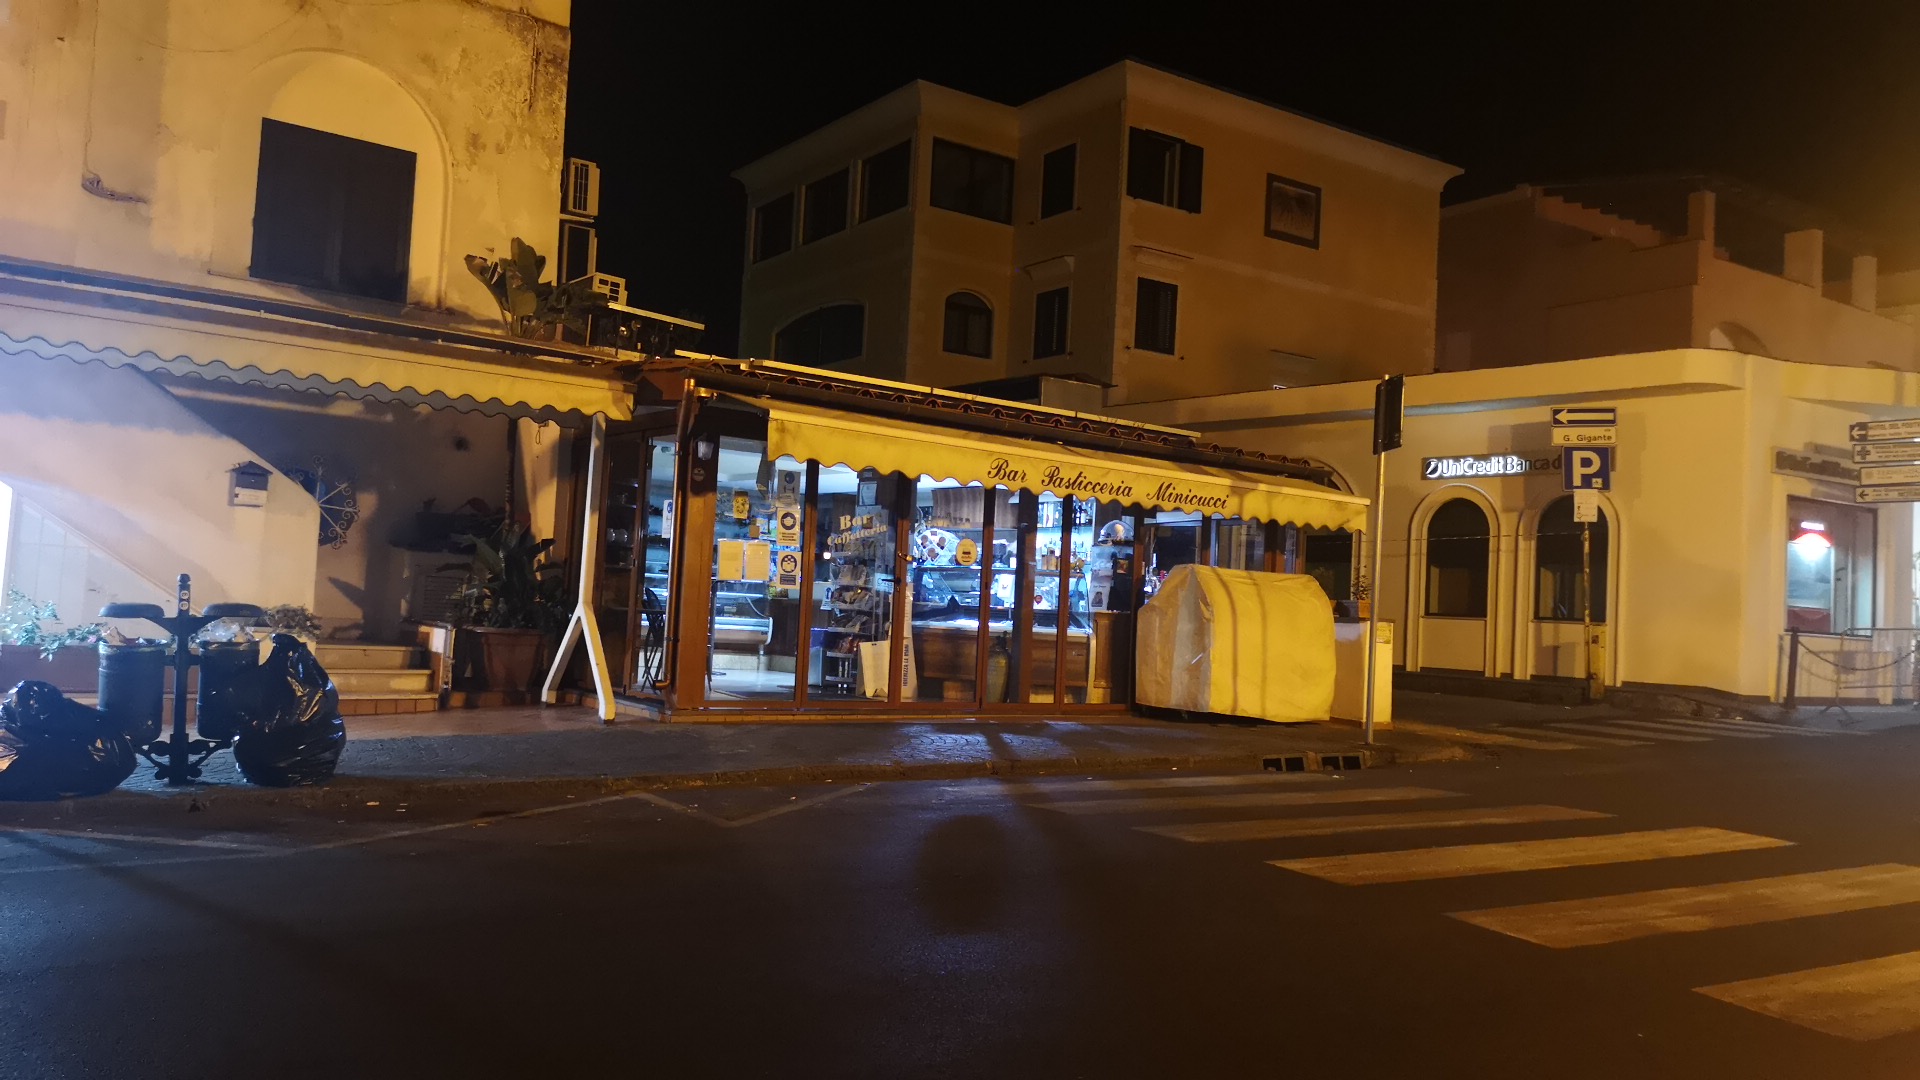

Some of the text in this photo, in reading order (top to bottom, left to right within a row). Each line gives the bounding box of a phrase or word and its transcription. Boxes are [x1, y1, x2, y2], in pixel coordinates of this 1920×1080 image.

[1563, 433, 1612, 442] G. Gigante
[1442, 457, 1503, 476] UniCredit
[1573, 451, 1600, 486] P
[988, 457, 1229, 510] Bar Pasticceria Minicucci
[839, 513, 872, 530] Bar
[827, 523, 888, 547] Caffetteria
